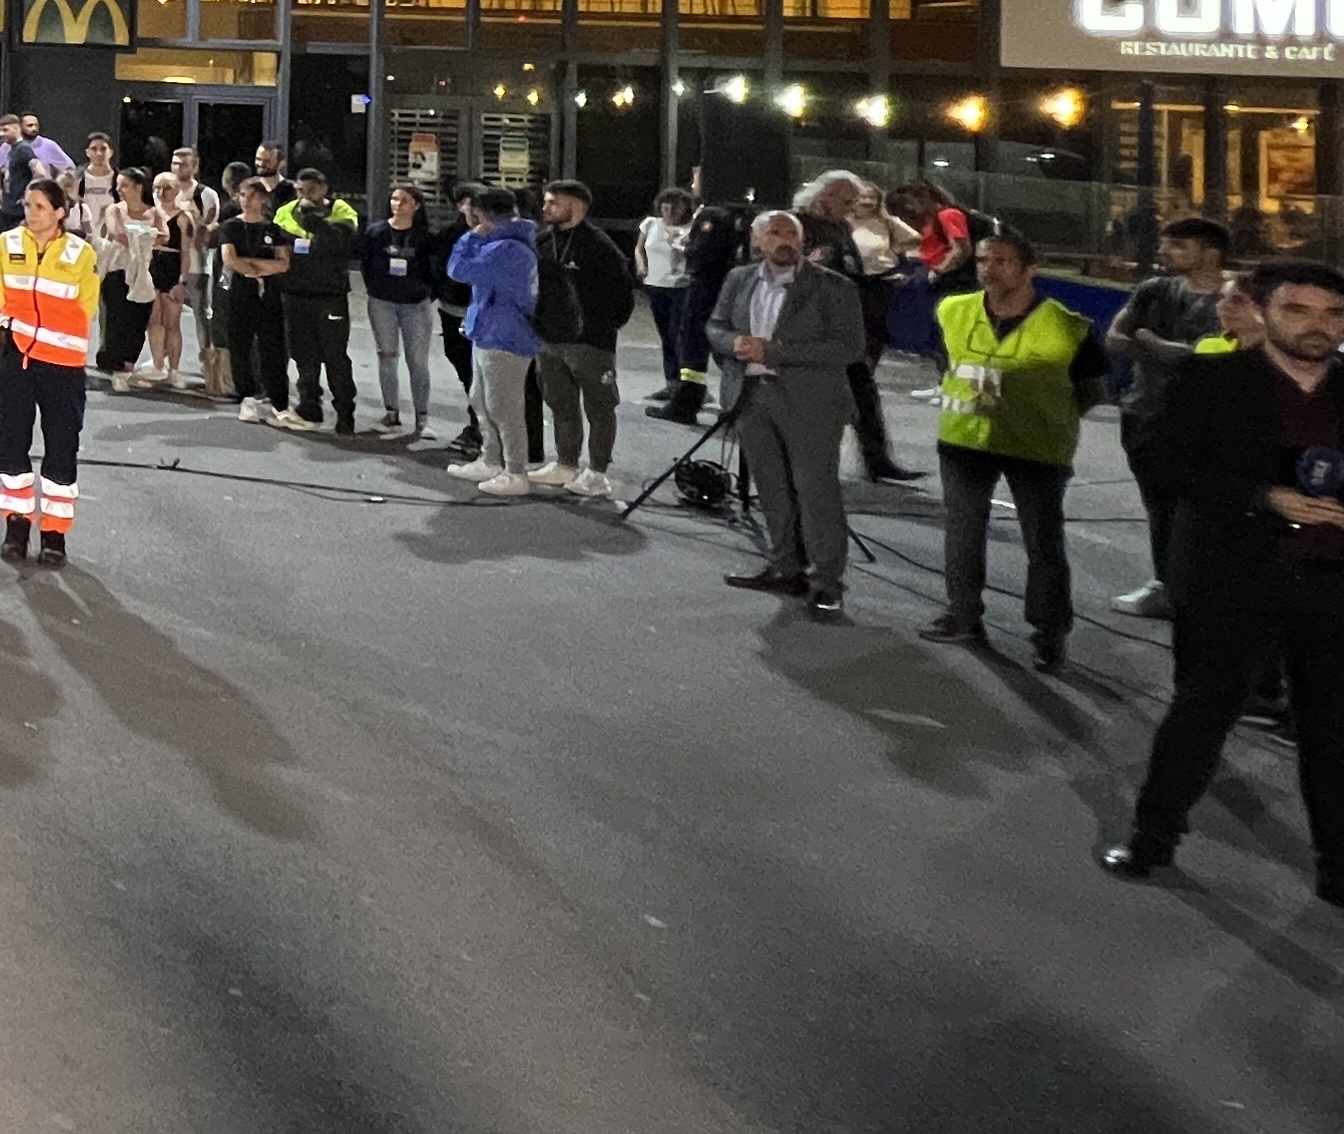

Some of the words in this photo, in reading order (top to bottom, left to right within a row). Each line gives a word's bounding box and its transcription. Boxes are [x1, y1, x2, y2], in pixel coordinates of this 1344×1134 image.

[1120, 40, 1258, 59] RESTAURANTE
[1264, 45, 1280, 60] &
[1284, 43, 1336, 62] CAFÉ
